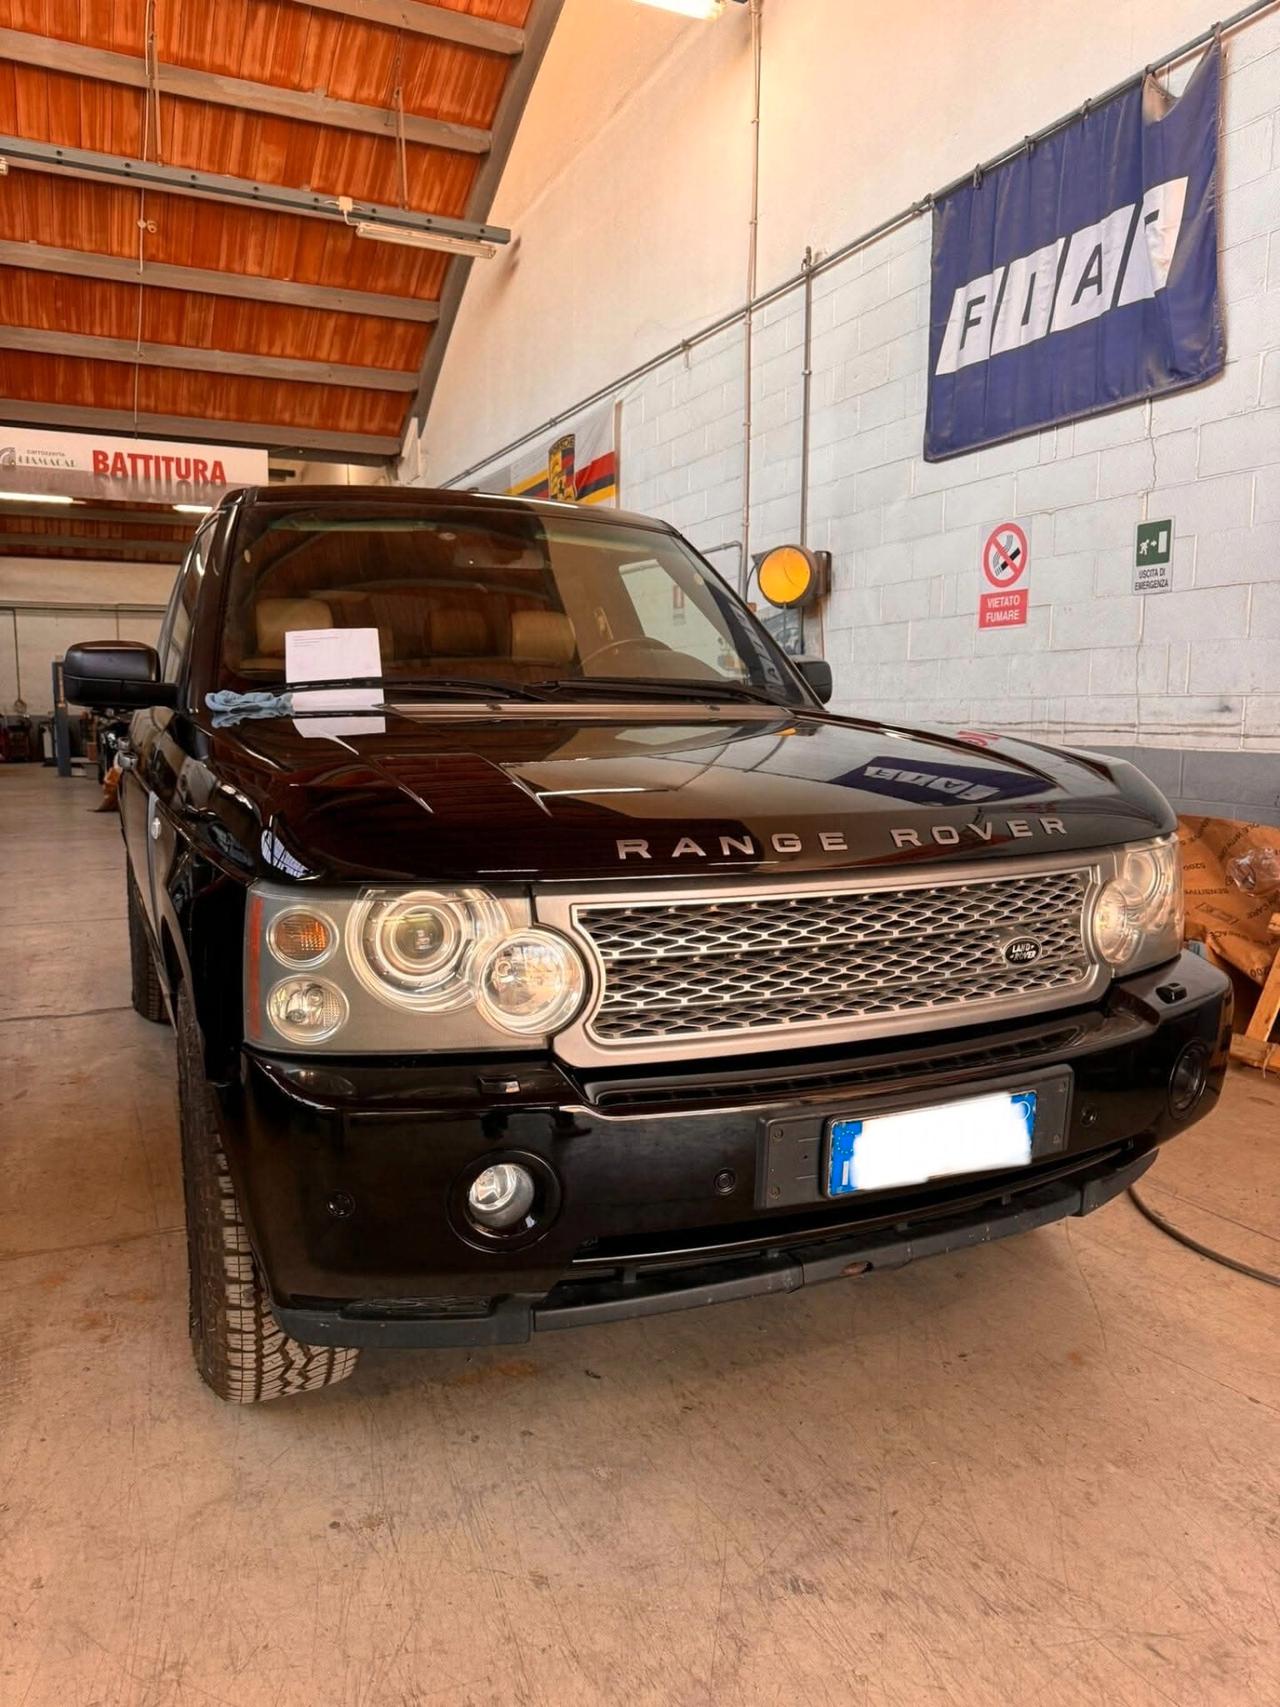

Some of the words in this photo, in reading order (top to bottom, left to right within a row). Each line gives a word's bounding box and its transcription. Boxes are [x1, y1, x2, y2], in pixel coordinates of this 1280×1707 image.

[92, 450, 227, 484] BATTITURA
[1139, 568, 1158, 579] USCITA
[1159, 567, 1166, 576] DI
[1135, 579, 1169, 591] EMERGENZA
[987, 595, 1021, 609] VIETATO
[985, 609, 1020, 622] FUMARE
[616, 832, 849, 860] RANGE
[889, 816, 1068, 849] ROVER
[1012, 943, 1031, 953] LAND
[1013, 950, 1037, 960] ROVER
